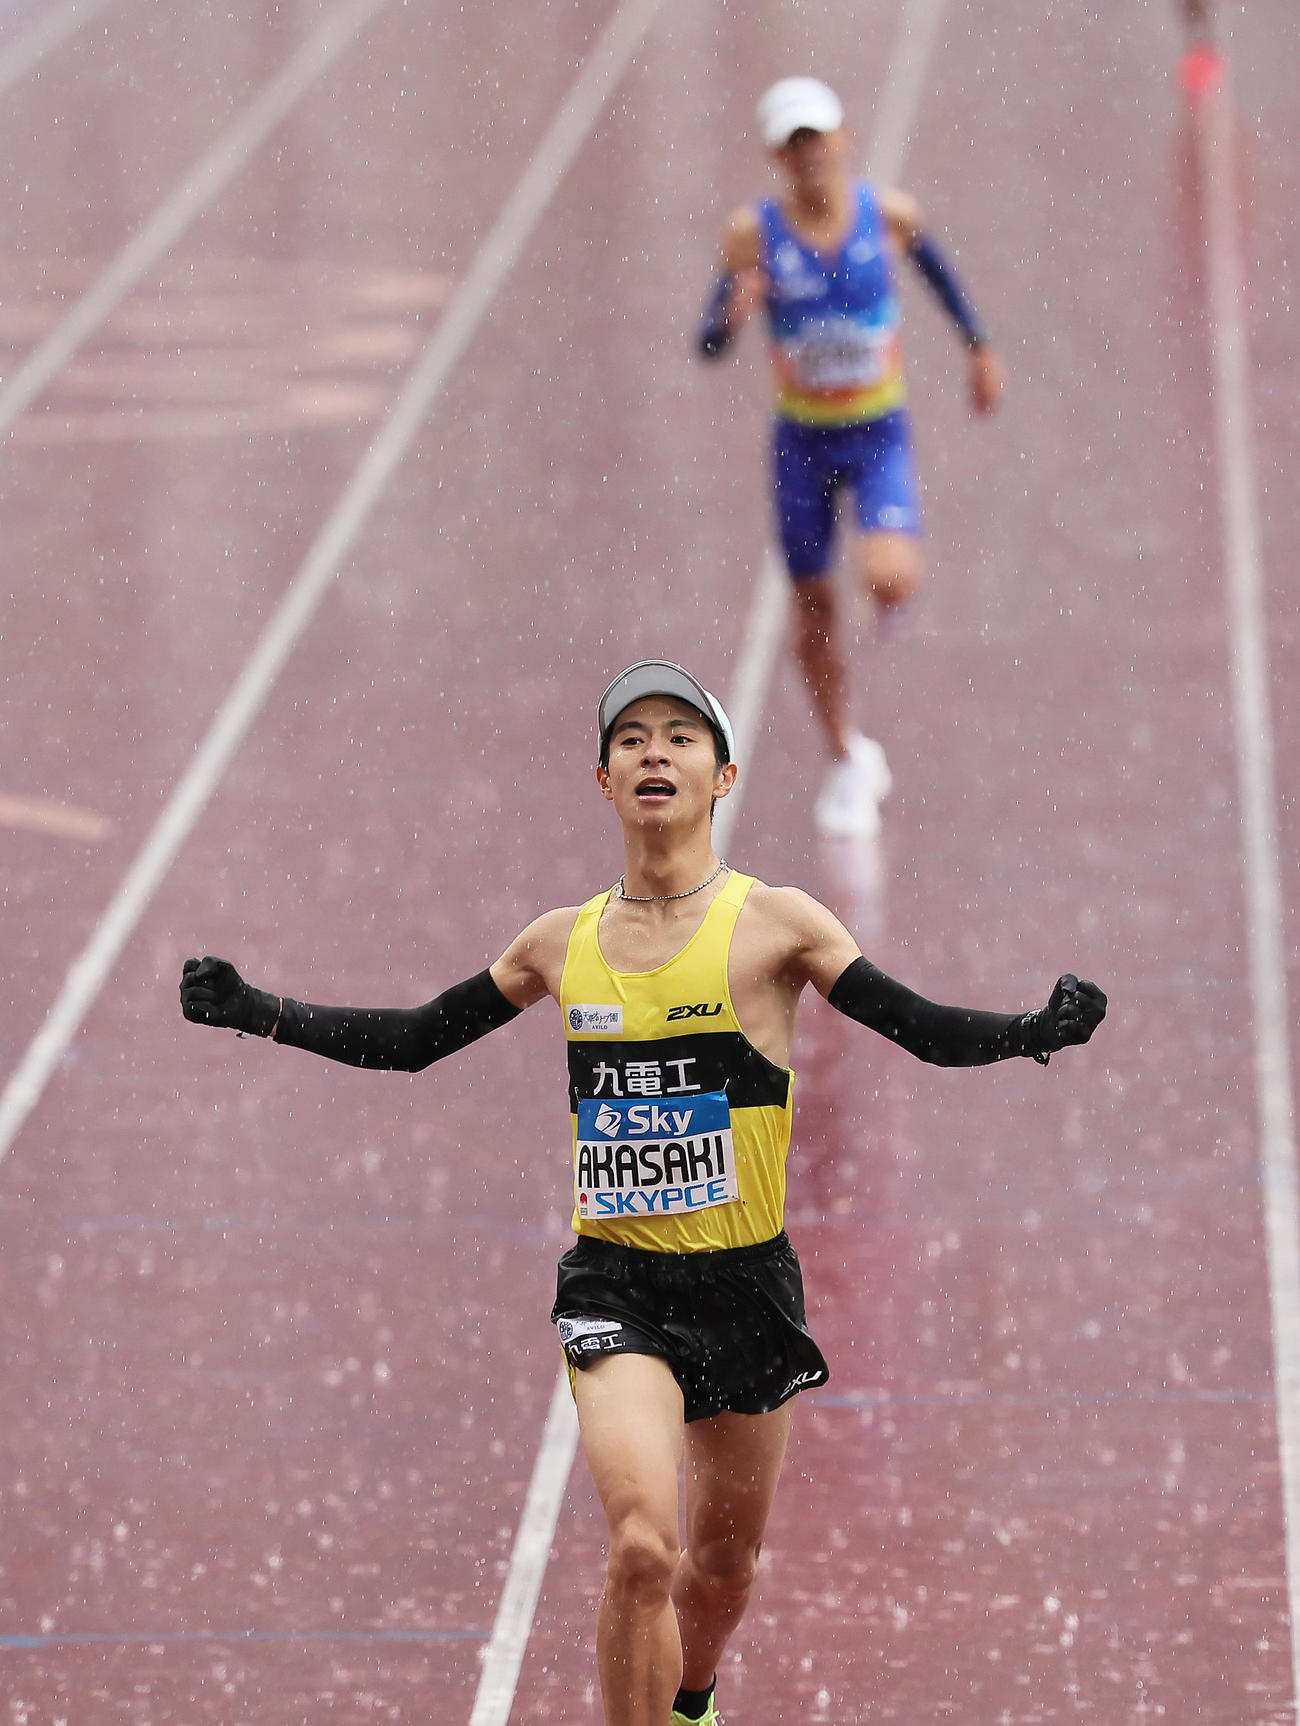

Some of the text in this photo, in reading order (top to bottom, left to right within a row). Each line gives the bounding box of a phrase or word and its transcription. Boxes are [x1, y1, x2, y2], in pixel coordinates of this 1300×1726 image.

[666, 1003, 723, 1021] 2XU
[592, 1057, 701, 1097] 九電工
[627, 1105, 693, 1135] Sky
[578, 1135, 726, 1189] AKASAKI
[595, 1178, 729, 1215] SKYPCE
